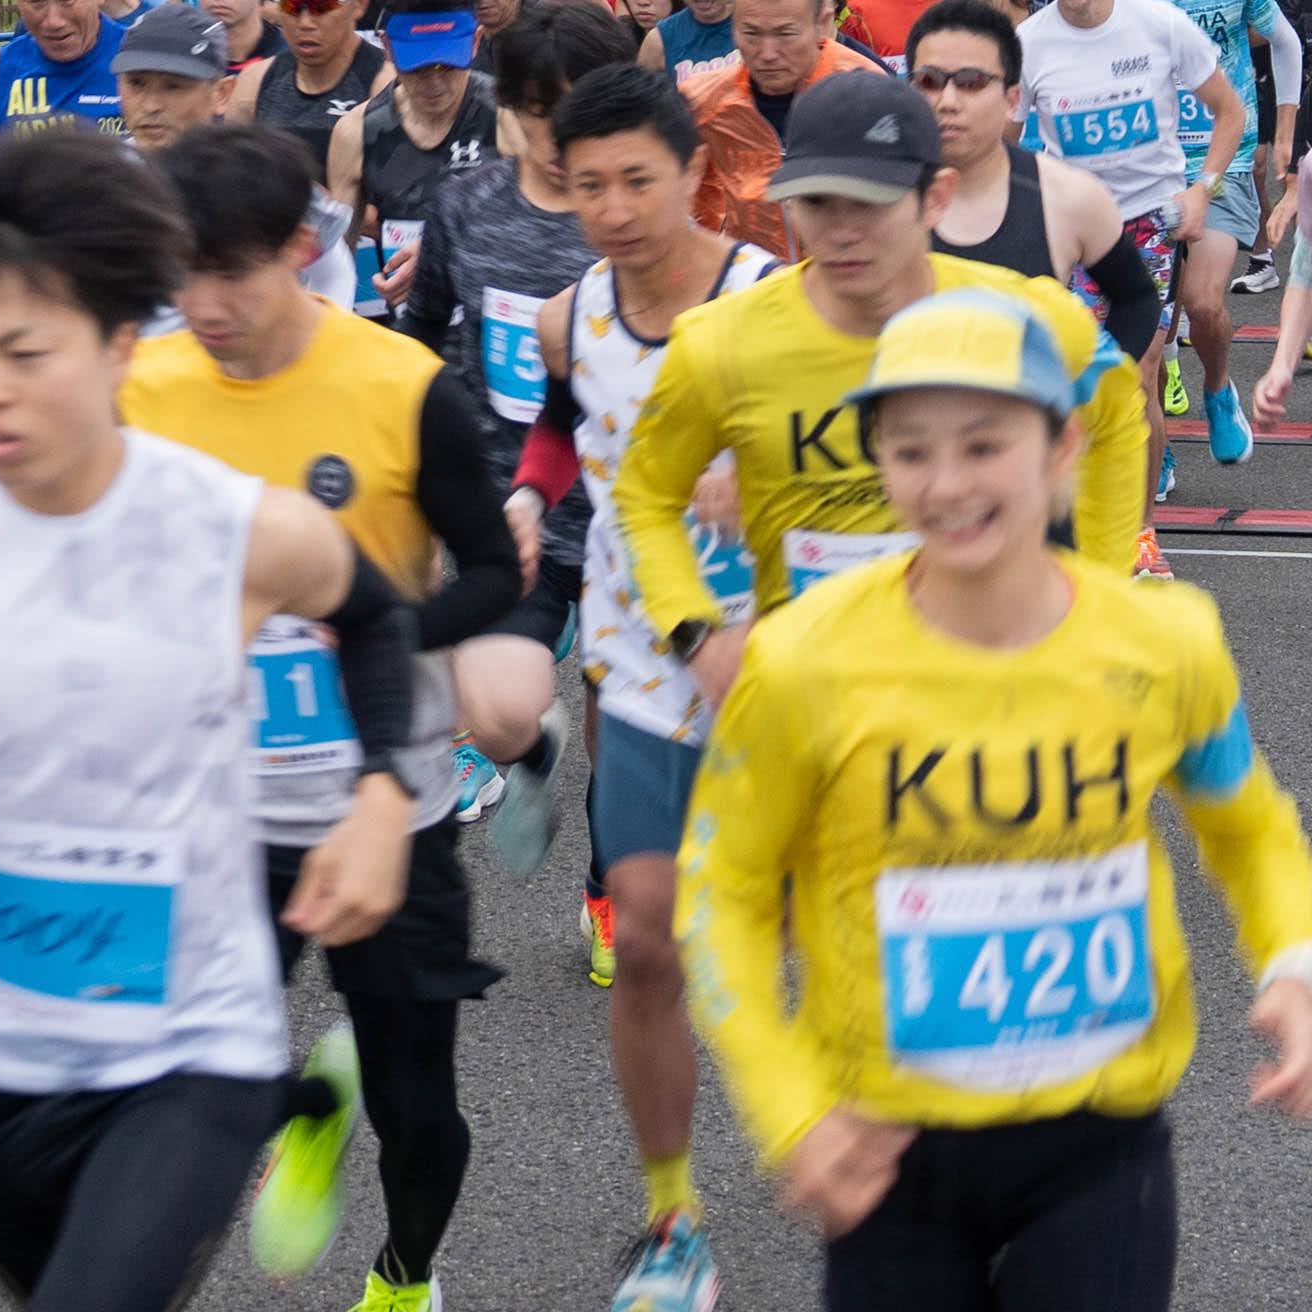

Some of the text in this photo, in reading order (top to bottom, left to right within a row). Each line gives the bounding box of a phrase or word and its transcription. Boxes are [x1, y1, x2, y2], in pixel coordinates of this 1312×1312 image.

[7, 76, 51, 117] ALL
[882, 733, 1131, 836] KUH
[959, 910, 1138, 1024] 420
